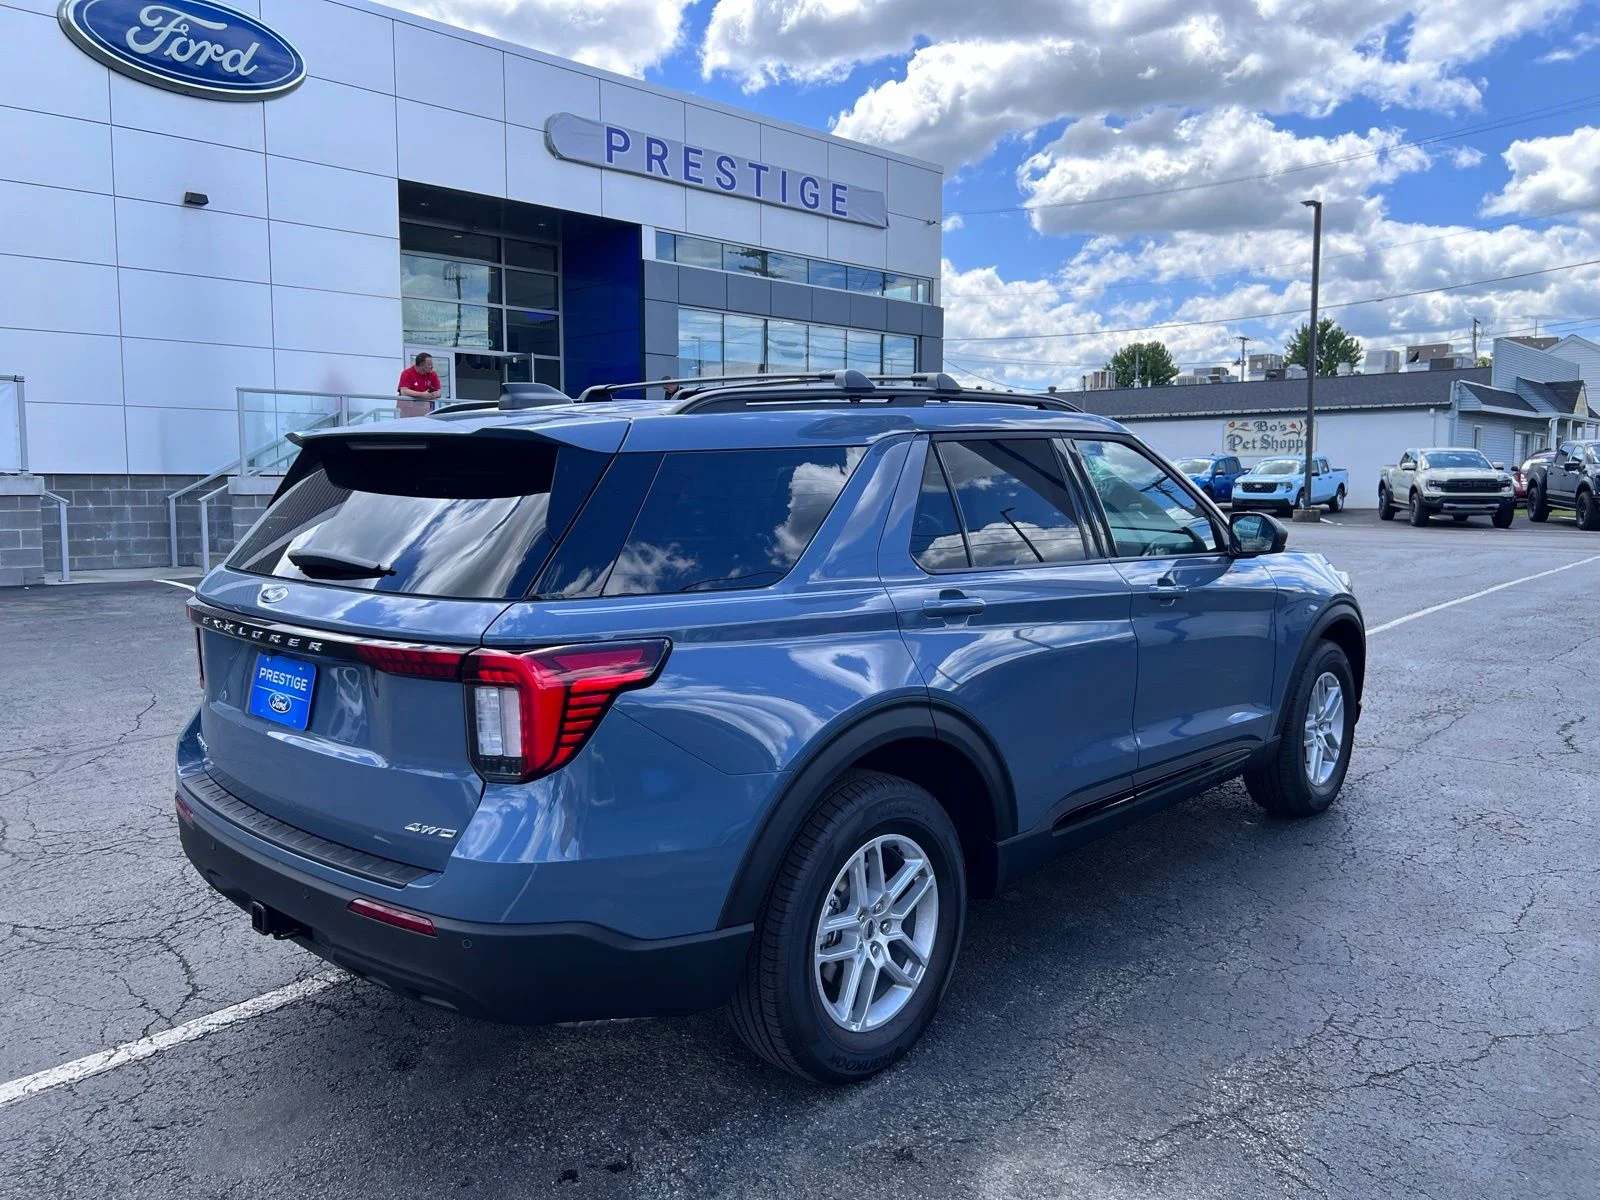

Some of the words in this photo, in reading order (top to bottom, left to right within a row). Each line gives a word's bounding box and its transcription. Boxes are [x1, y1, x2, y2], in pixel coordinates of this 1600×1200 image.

[125, 5, 261, 77] Ford
[604, 125, 849, 217] PRESTIGE
[1253, 420, 1287, 432] Bo's
[1226, 433, 1257, 452] Pet
[1260, 434, 1307, 454] Shopp
[202, 617, 322, 651] EXPLORER
[258, 667, 308, 691] PRESTIGE
[271, 695, 288, 710] Ford
[404, 822, 457, 838] 4WD
